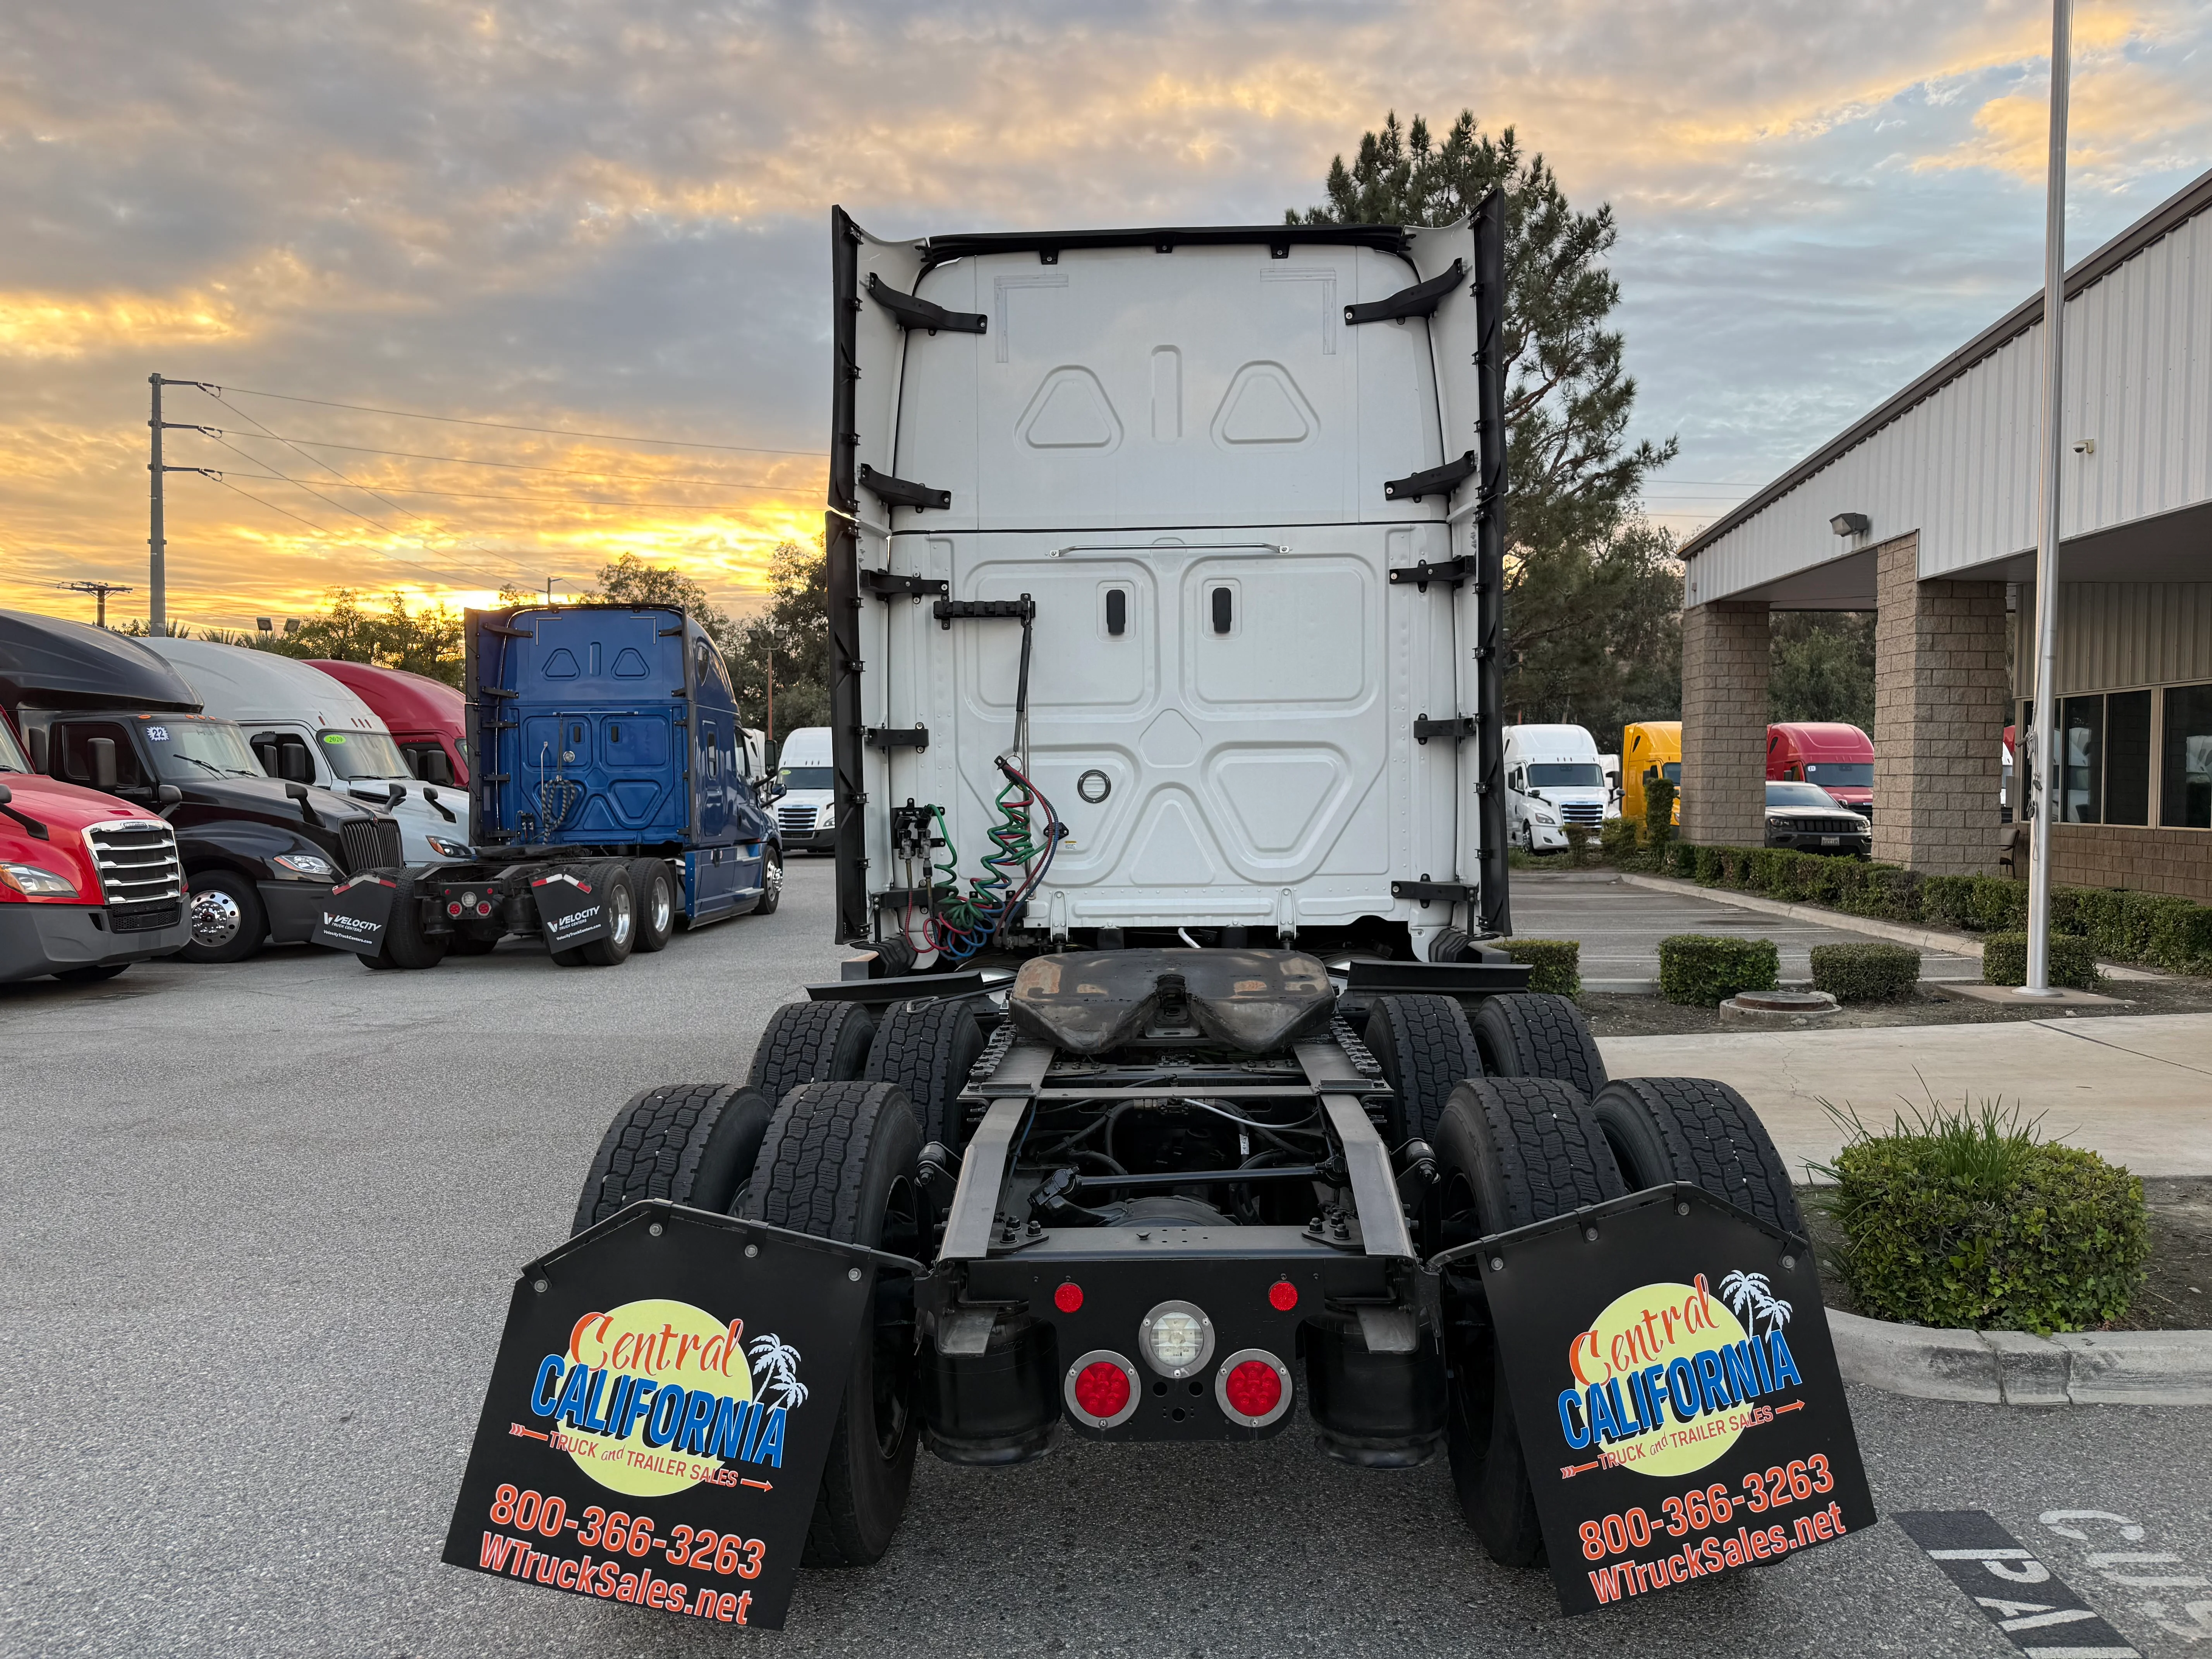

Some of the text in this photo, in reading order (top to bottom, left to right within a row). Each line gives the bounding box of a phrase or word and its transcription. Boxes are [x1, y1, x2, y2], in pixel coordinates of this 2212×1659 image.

[152, 729, 165, 738] 22
[323, 929, 372, 944] VelocityTruckCenters.com
[334, 915, 382, 931] VELOCITY
[556, 924, 601, 941] VelocityTruckCenters.com
[559, 905, 600, 926] VELOCITY
[570, 1312, 744, 1377] Central
[1569, 1273, 1720, 1387] Central
[531, 1354, 788, 1468] CALIFORNIA
[1558, 1329, 1802, 1449] CALIFORNIA
[549, 1431, 739, 1487] TRUCK and TRAILER SALES
[1598, 1406, 1774, 1470] TRUCK and TRAILER SALES
[490, 1483, 766, 1579] 800-366-3263
[1579, 1453, 1834, 1560] 800-366-3263
[479, 1531, 752, 1625] WTruckSales.net
[1588, 1501, 1846, 1604] WTruckSales.net
[1927, 1549, 2143, 1659] PA
